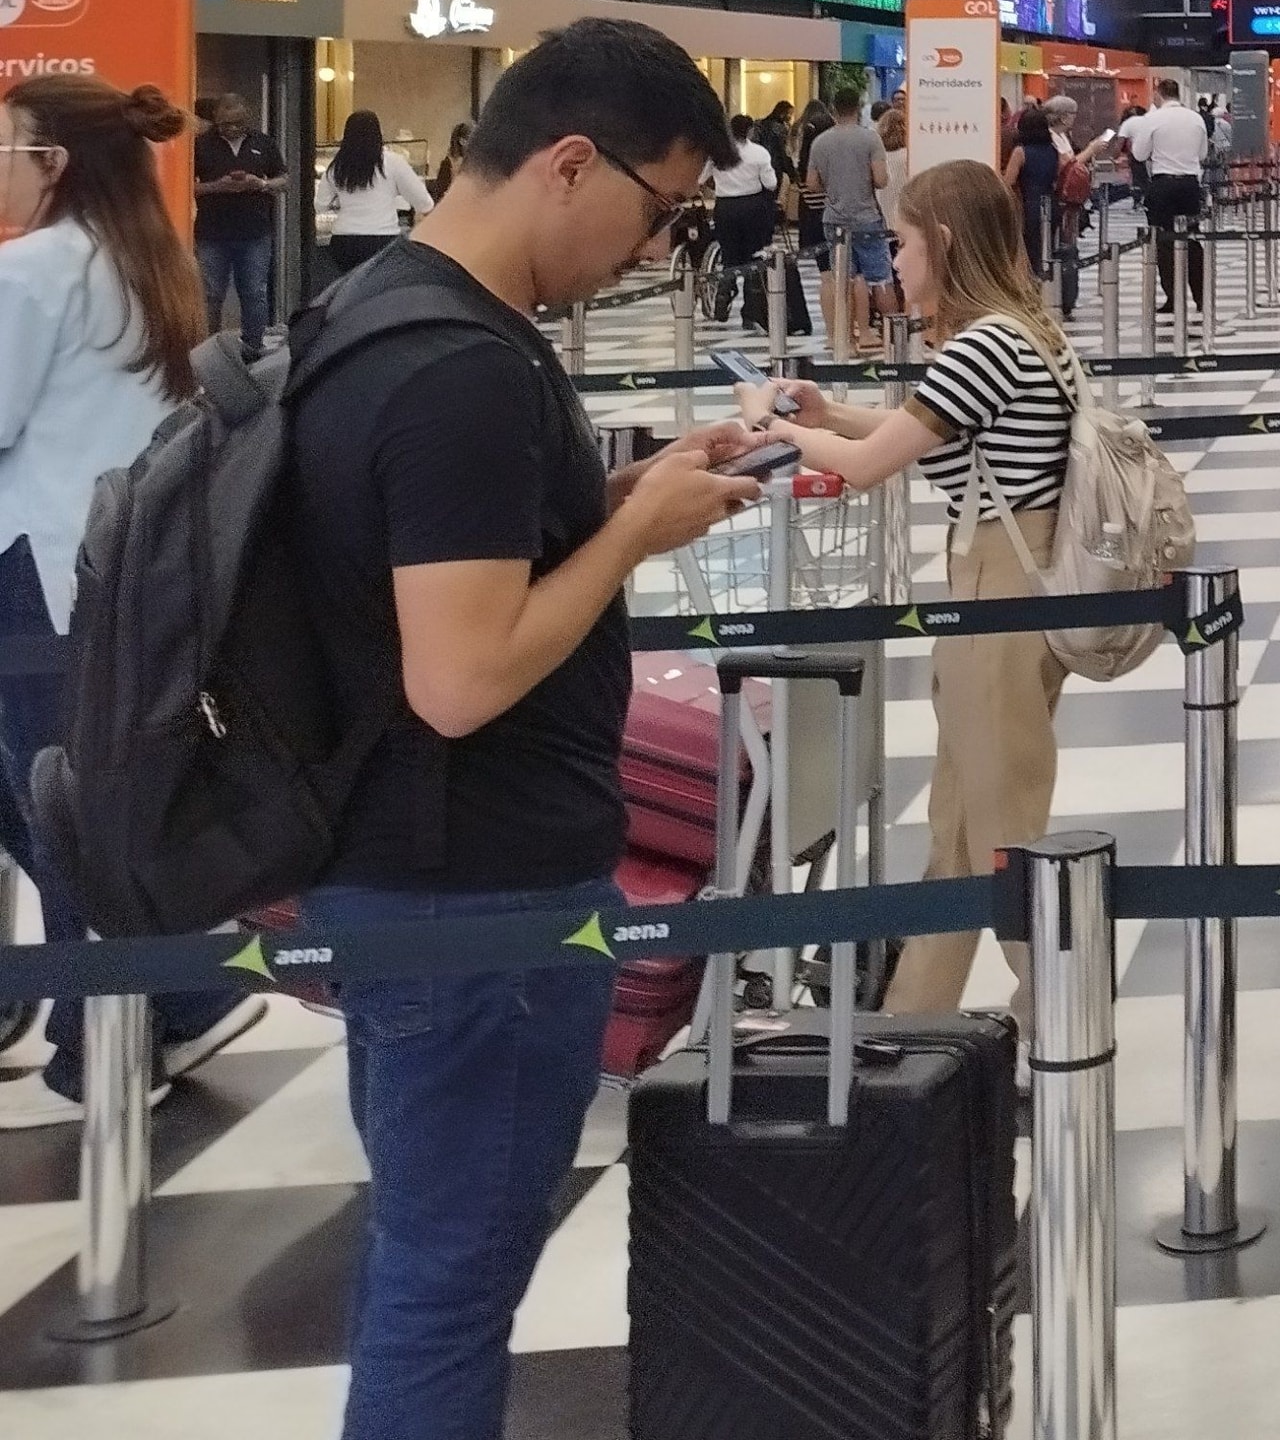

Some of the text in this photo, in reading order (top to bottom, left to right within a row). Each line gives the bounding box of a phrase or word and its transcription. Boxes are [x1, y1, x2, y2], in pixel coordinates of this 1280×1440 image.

[964, 0, 998, 15] GOL
[918, 78, 983, 89] Prioridades
[926, 611, 961, 626] aena
[1203, 609, 1233, 635] aena
[718, 622, 755, 637] aena
[613, 921, 670, 942] aena
[274, 946, 333, 966] aena
